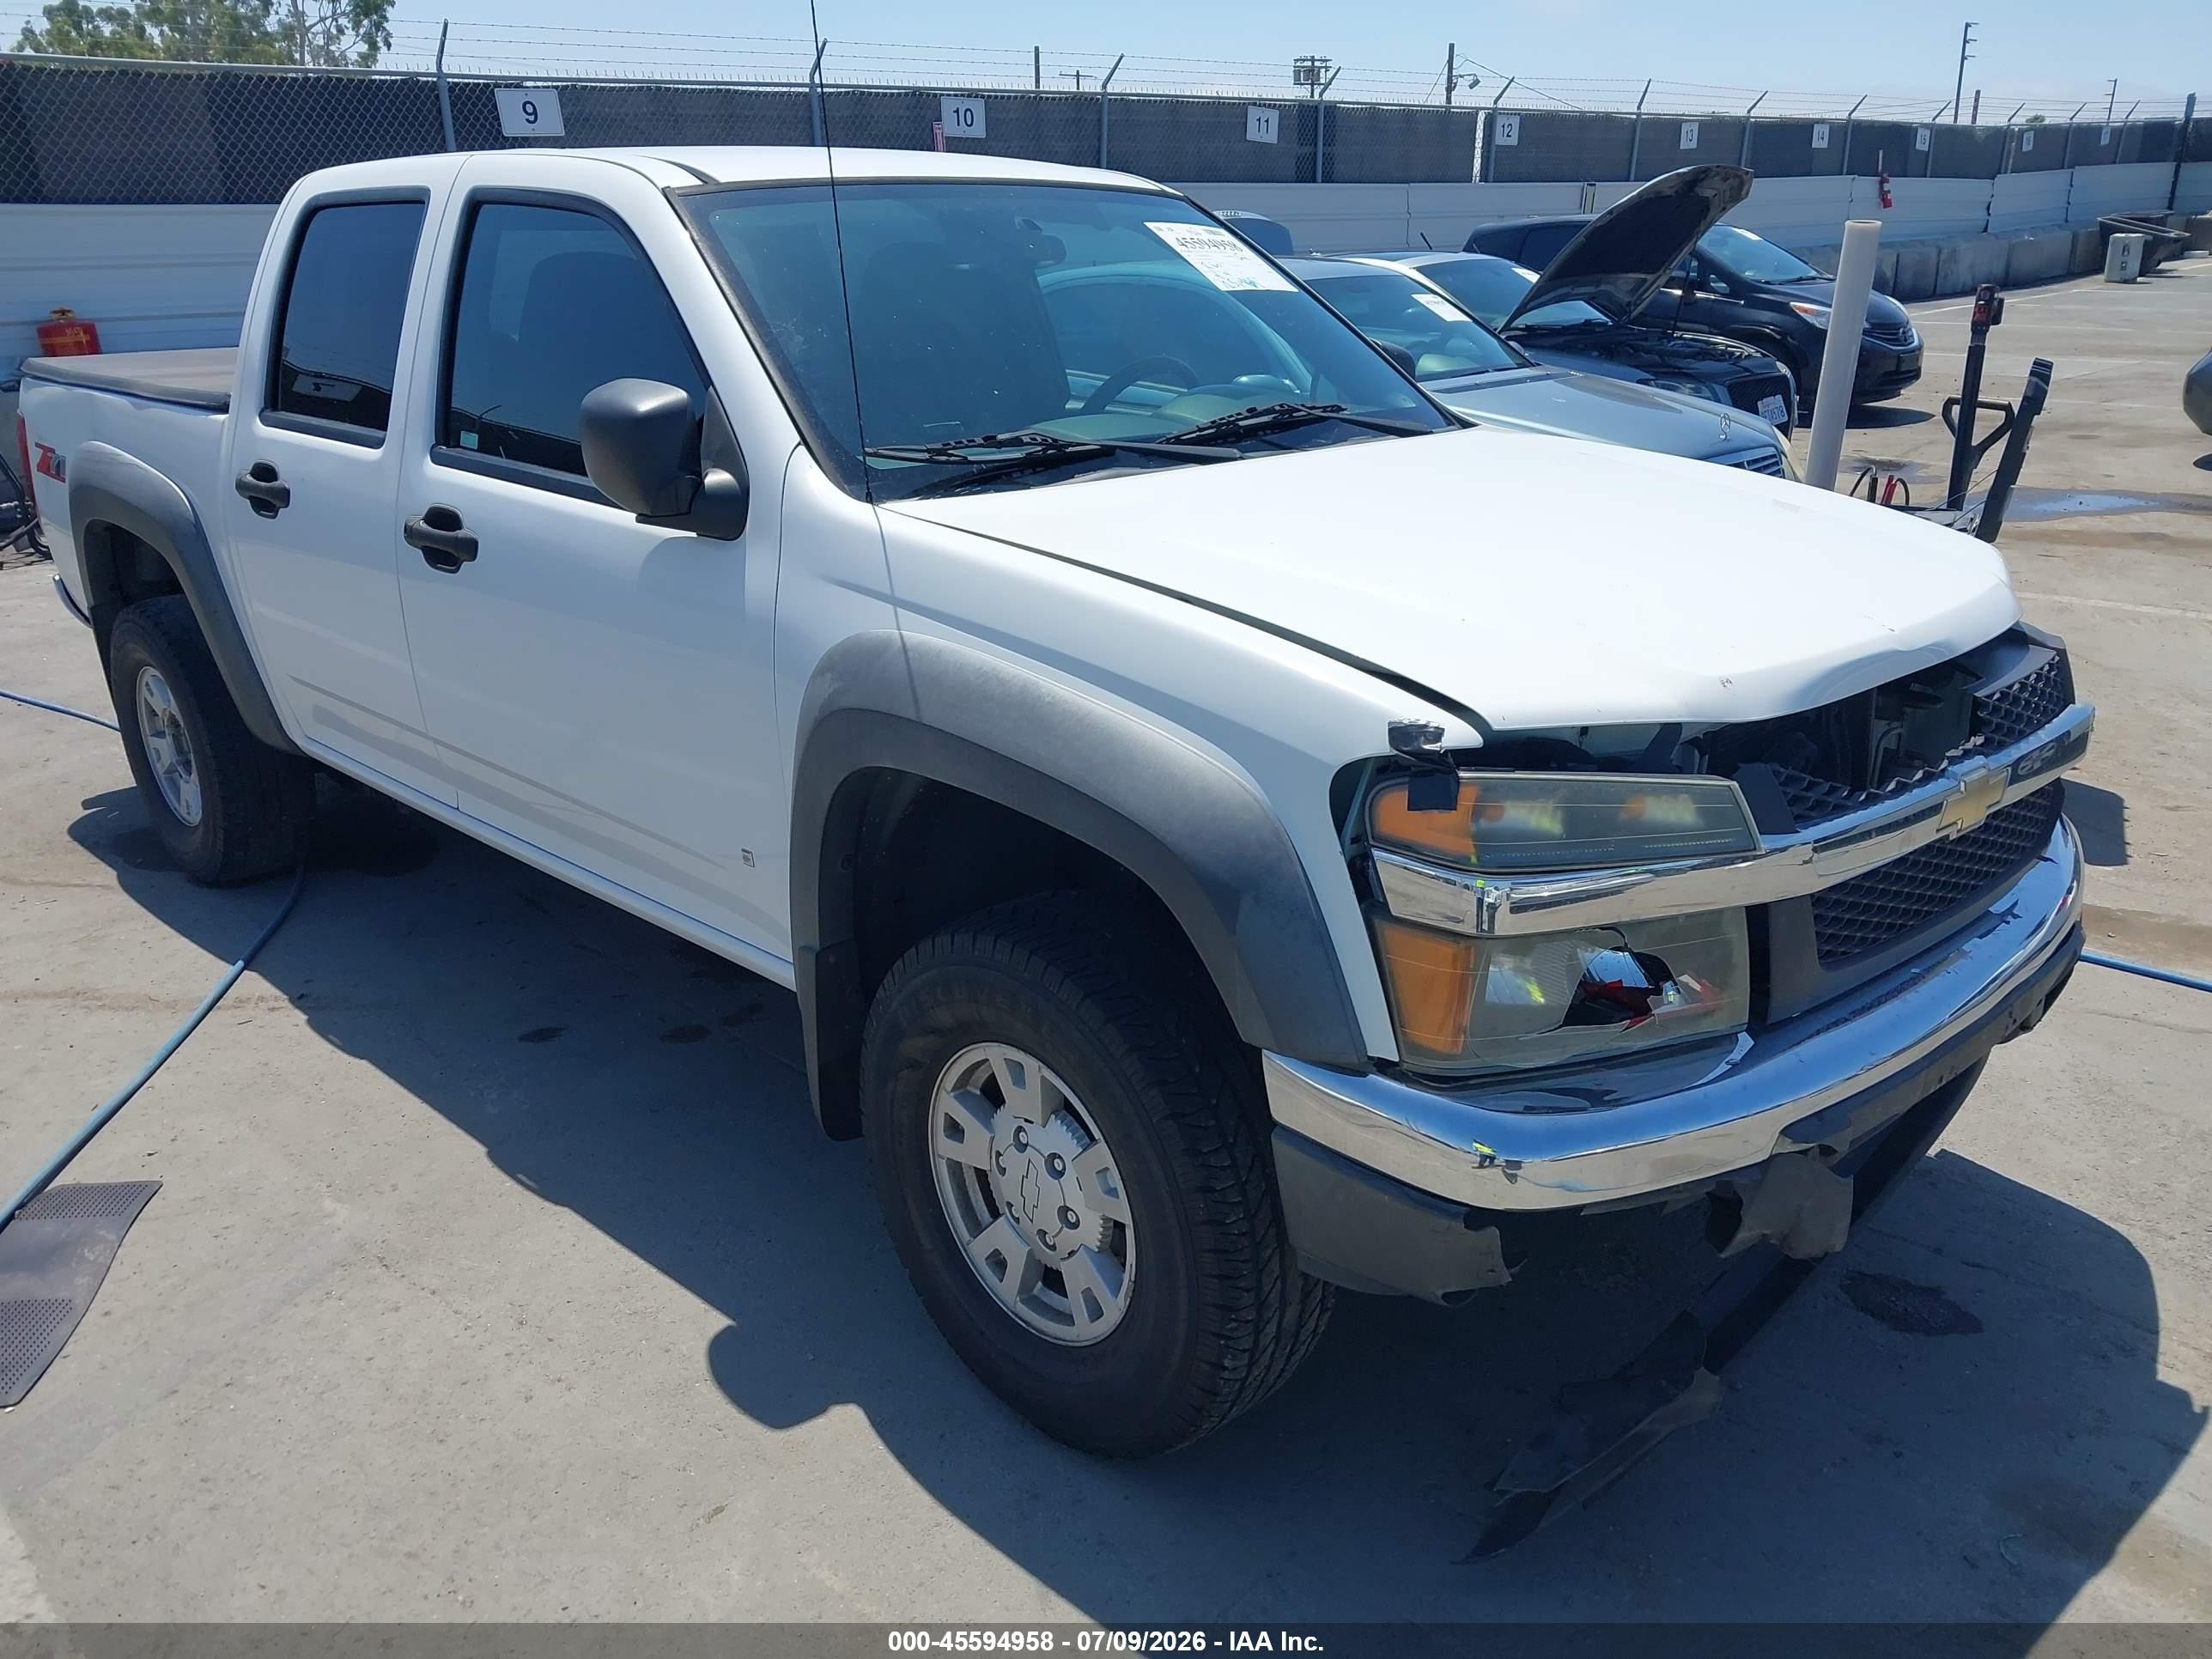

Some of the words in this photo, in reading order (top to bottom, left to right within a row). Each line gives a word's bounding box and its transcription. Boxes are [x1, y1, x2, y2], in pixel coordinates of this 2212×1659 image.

[521, 100, 538, 125] 9
[952, 106, 975, 127] 10
[1256, 116, 1269, 134] 11
[1501, 123, 1513, 137] 12
[1686, 129, 1694, 143] 13
[1817, 130, 1825, 143] 14
[1175, 236, 1244, 252] 45594958
